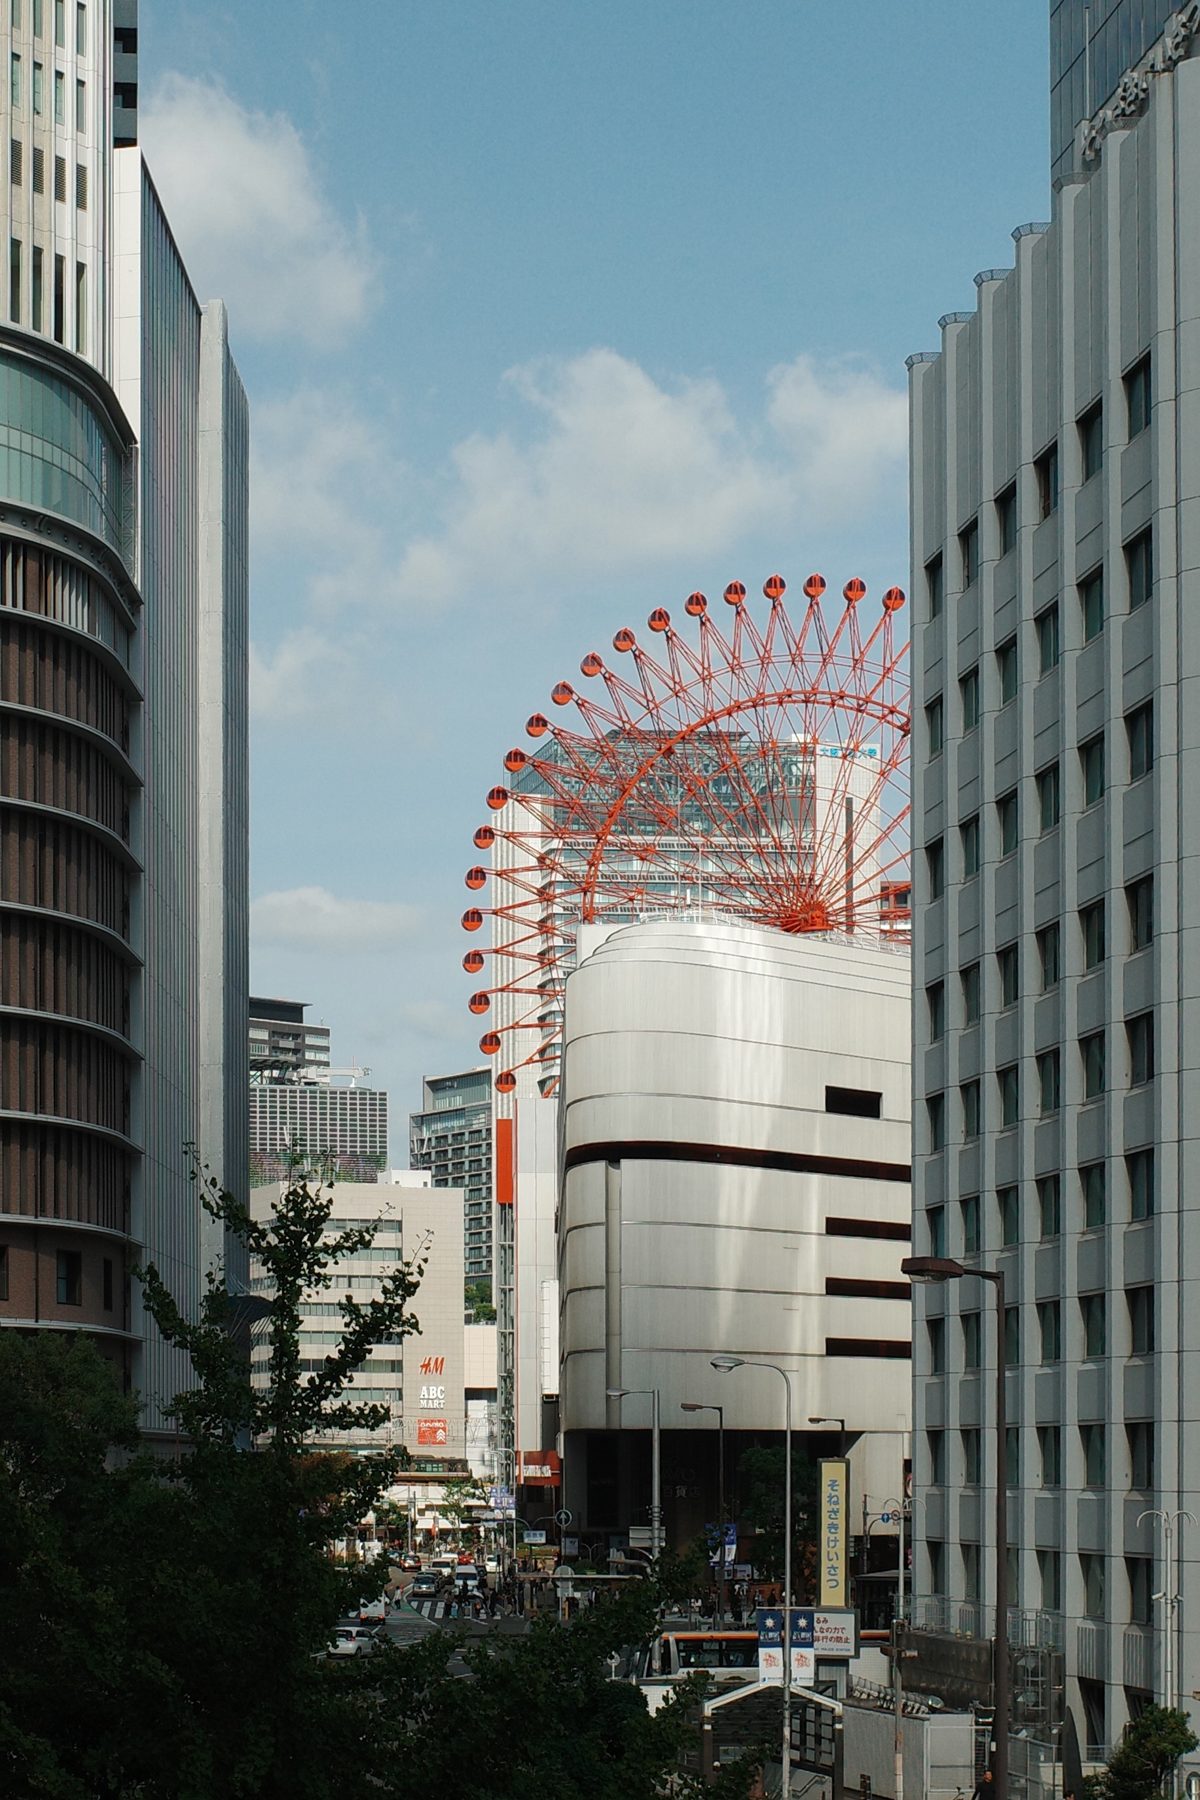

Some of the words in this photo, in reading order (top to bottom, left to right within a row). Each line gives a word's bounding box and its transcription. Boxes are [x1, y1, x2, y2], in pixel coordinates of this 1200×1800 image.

[420, 1357, 445, 1375] H&M
[420, 1386, 445, 1399] ABC
[420, 1400, 445, 1408] MART
[826, 1479, 840, 1589] そねざきけいさつ
